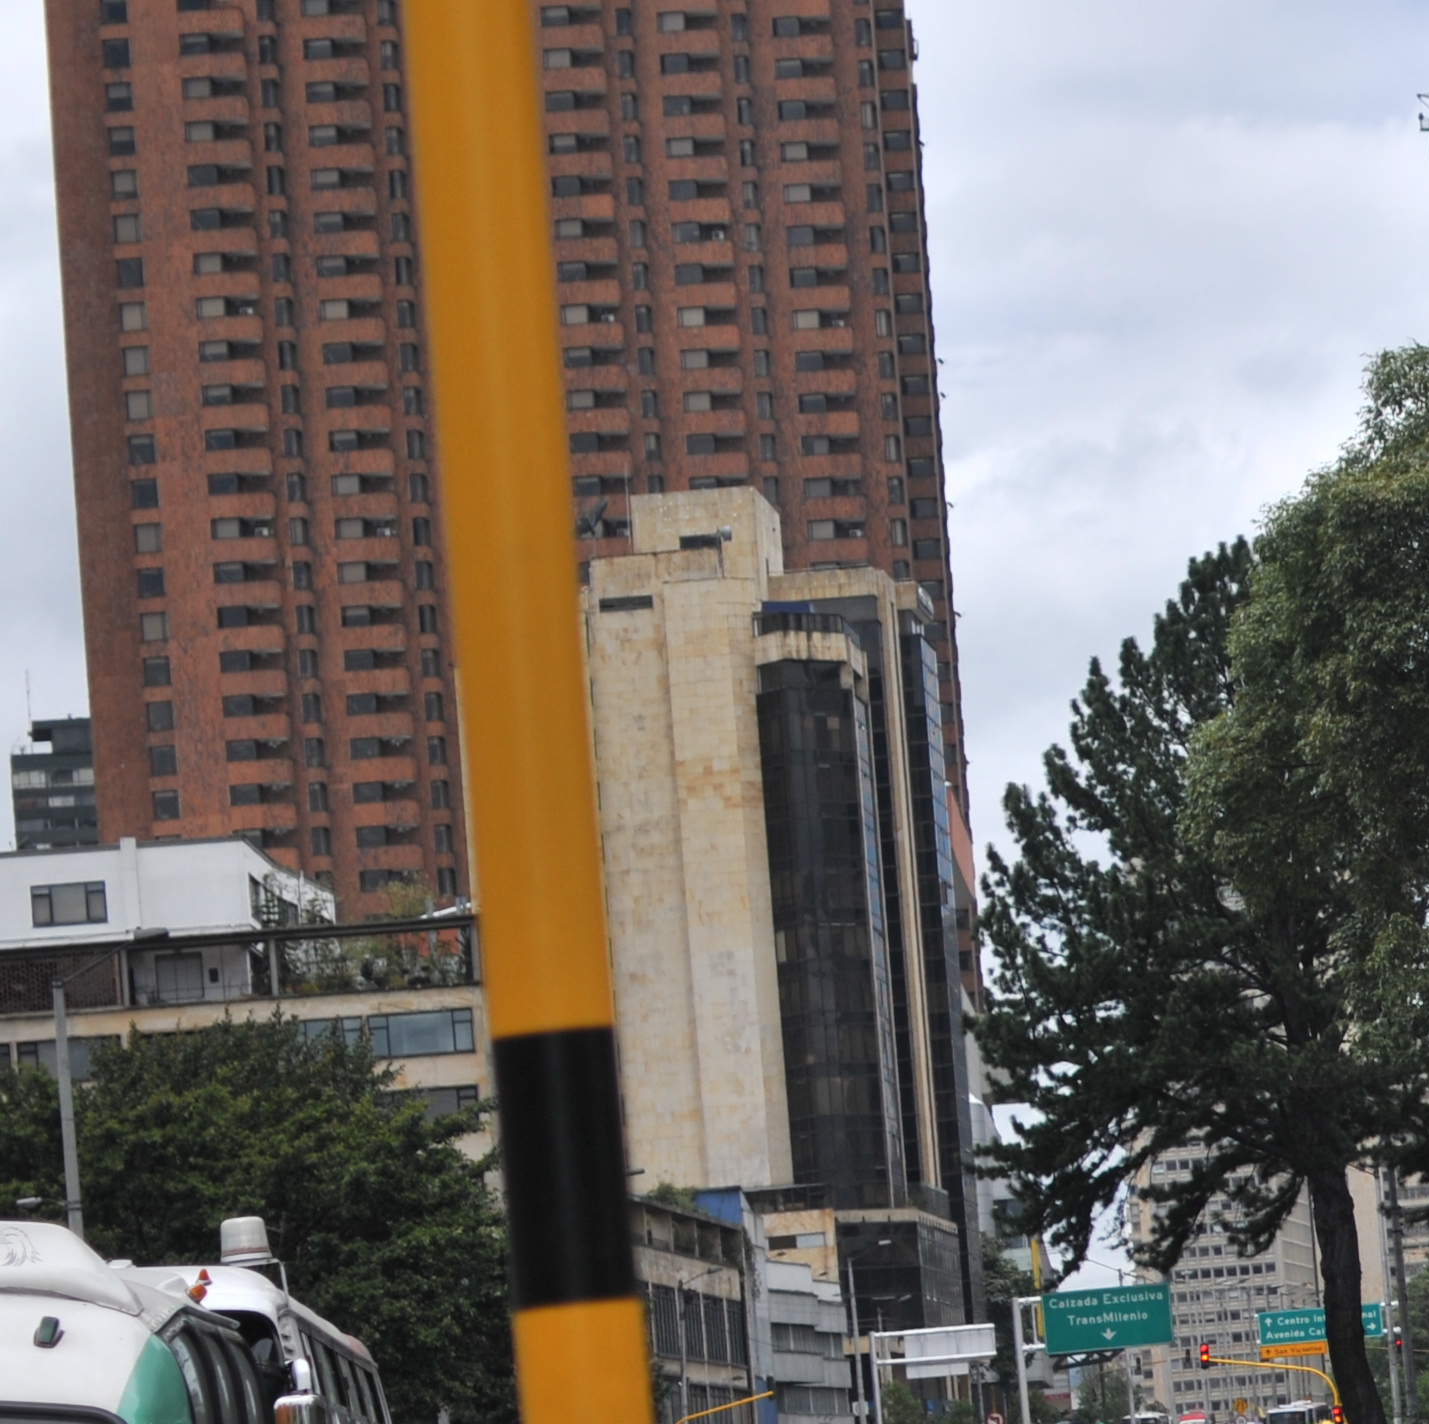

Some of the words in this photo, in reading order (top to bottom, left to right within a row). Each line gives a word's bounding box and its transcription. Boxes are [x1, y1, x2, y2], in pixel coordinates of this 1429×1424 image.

[1049, 1298, 1098, 1309] Calzada
[1102, 1291, 1163, 1305] Exclusiva
[1067, 1311, 1148, 1326] TransMilenio
[1277, 1316, 1310, 1326] Centro
[1265, 1329, 1305, 1340] Avenida
